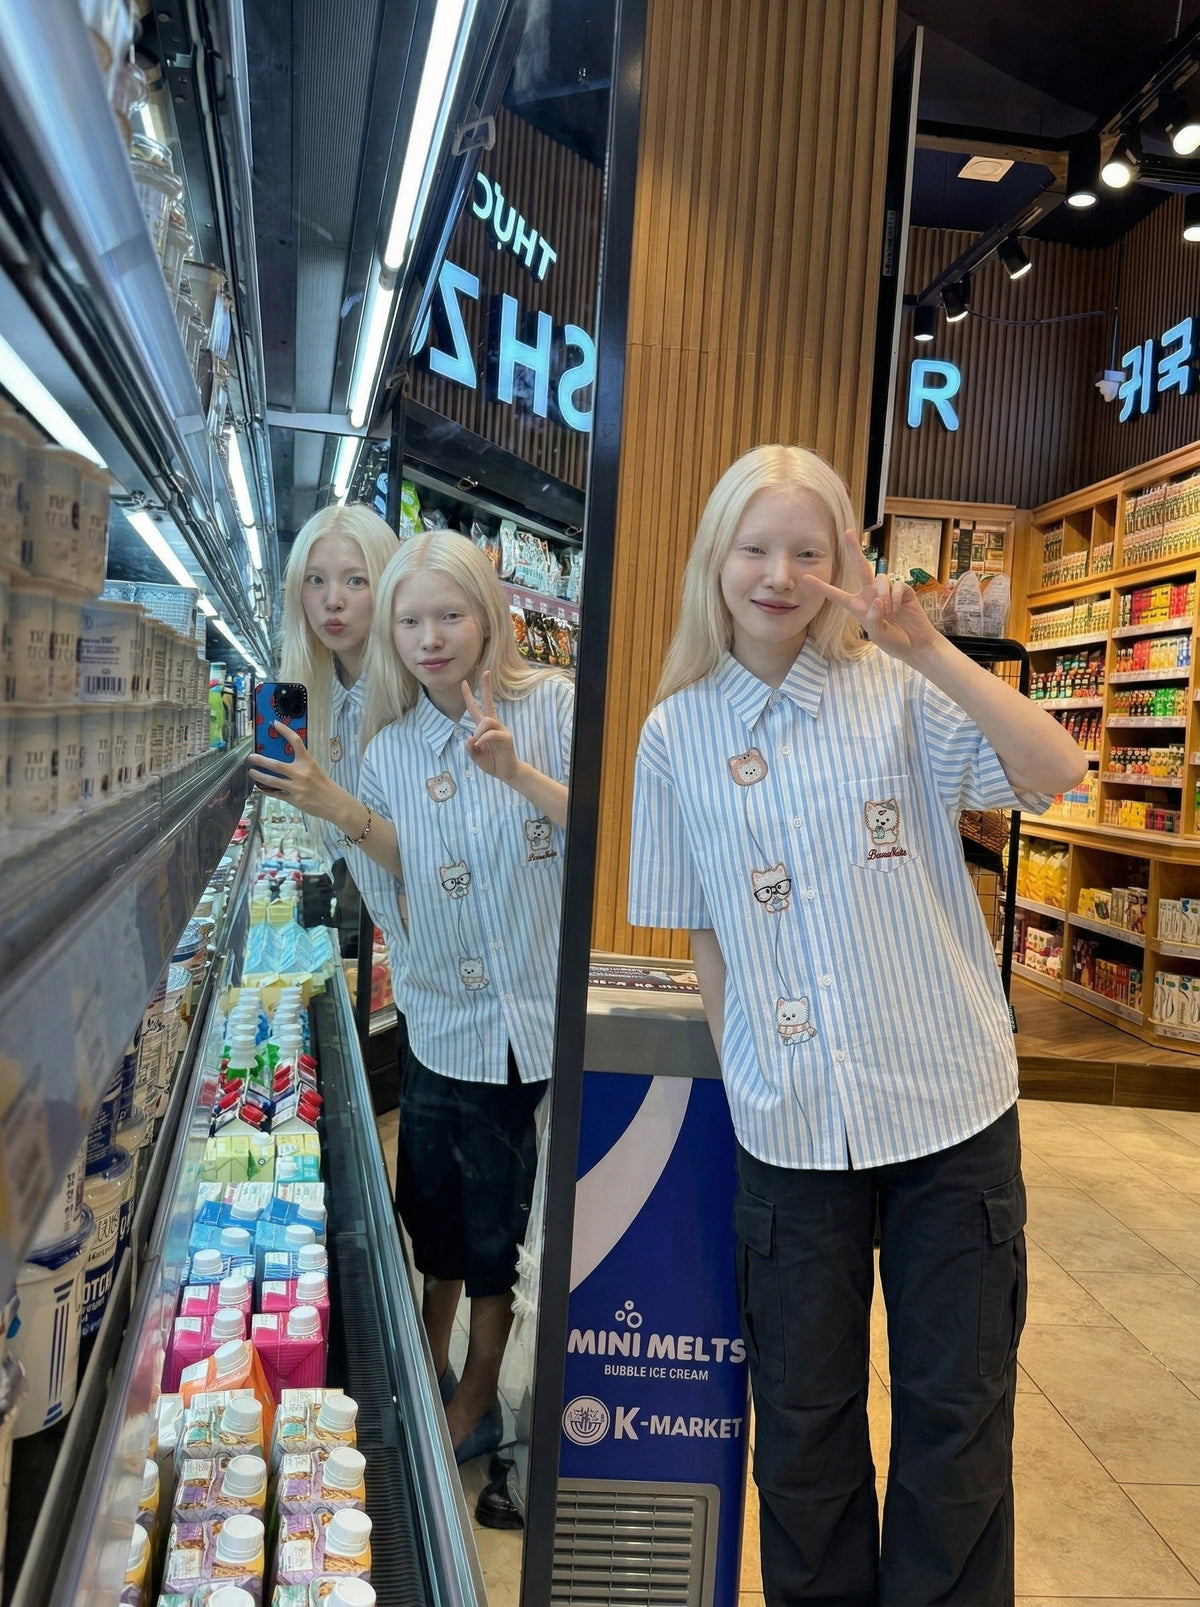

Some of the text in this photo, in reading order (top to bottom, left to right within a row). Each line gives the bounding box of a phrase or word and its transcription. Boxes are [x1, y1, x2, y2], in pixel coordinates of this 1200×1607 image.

[906, 358, 962, 432] R
[567, 1328, 747, 1364] MINI MELTS
[604, 1364, 709, 1381] BUBBLE ICE CREAM
[614, 1406, 743, 1440] K-MARKET
